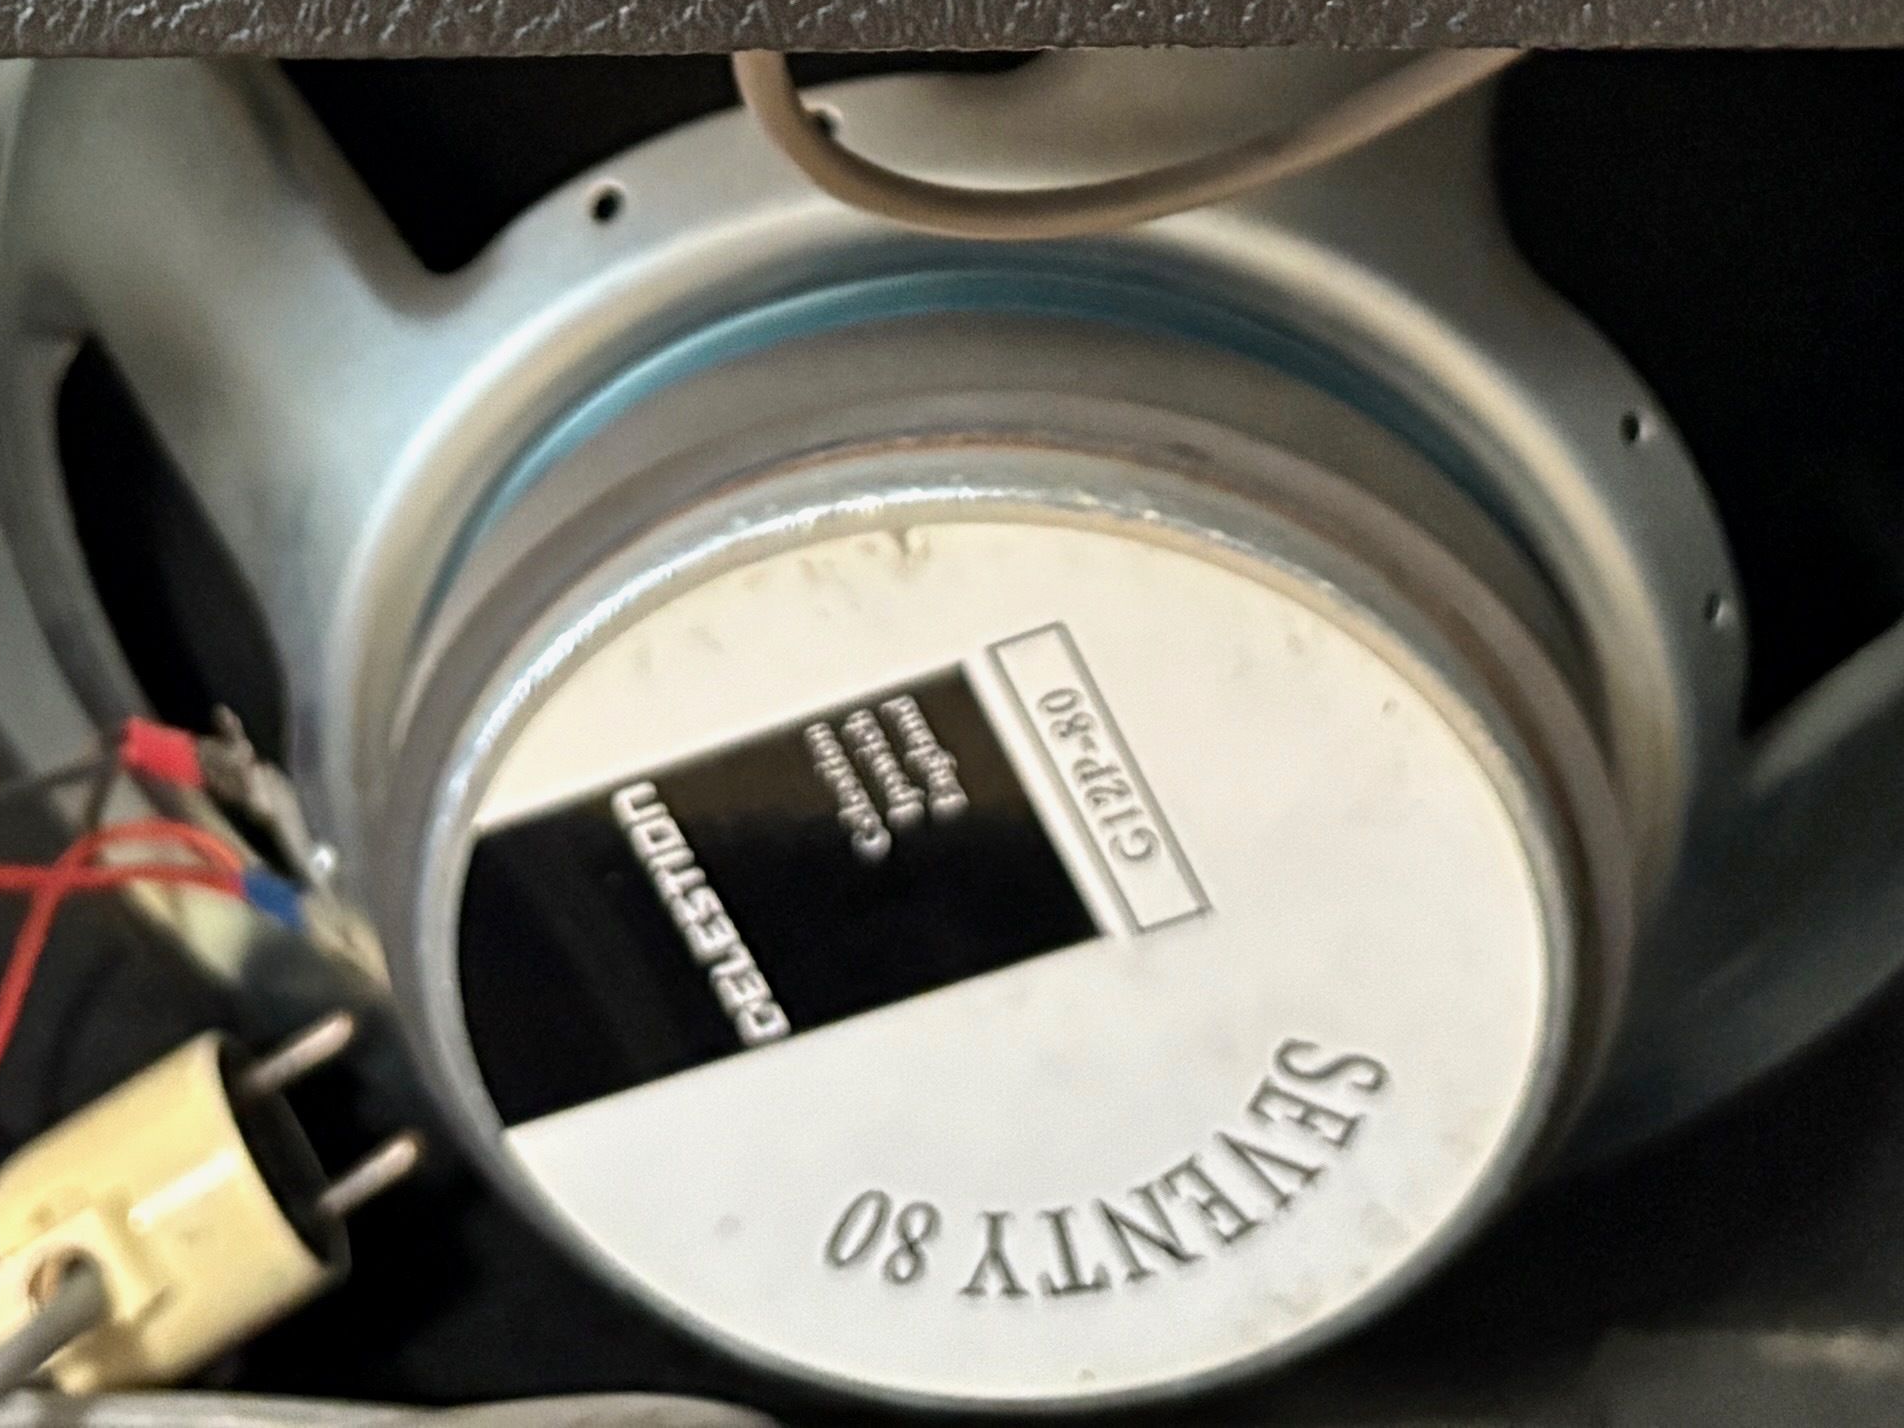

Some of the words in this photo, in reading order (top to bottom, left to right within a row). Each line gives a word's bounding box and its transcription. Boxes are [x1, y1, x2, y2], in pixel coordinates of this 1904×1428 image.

[611, 780, 791, 1044] CELESTION
[825, 1189, 942, 1286] 80
[957, 1038, 1390, 1298] SEVENTY
